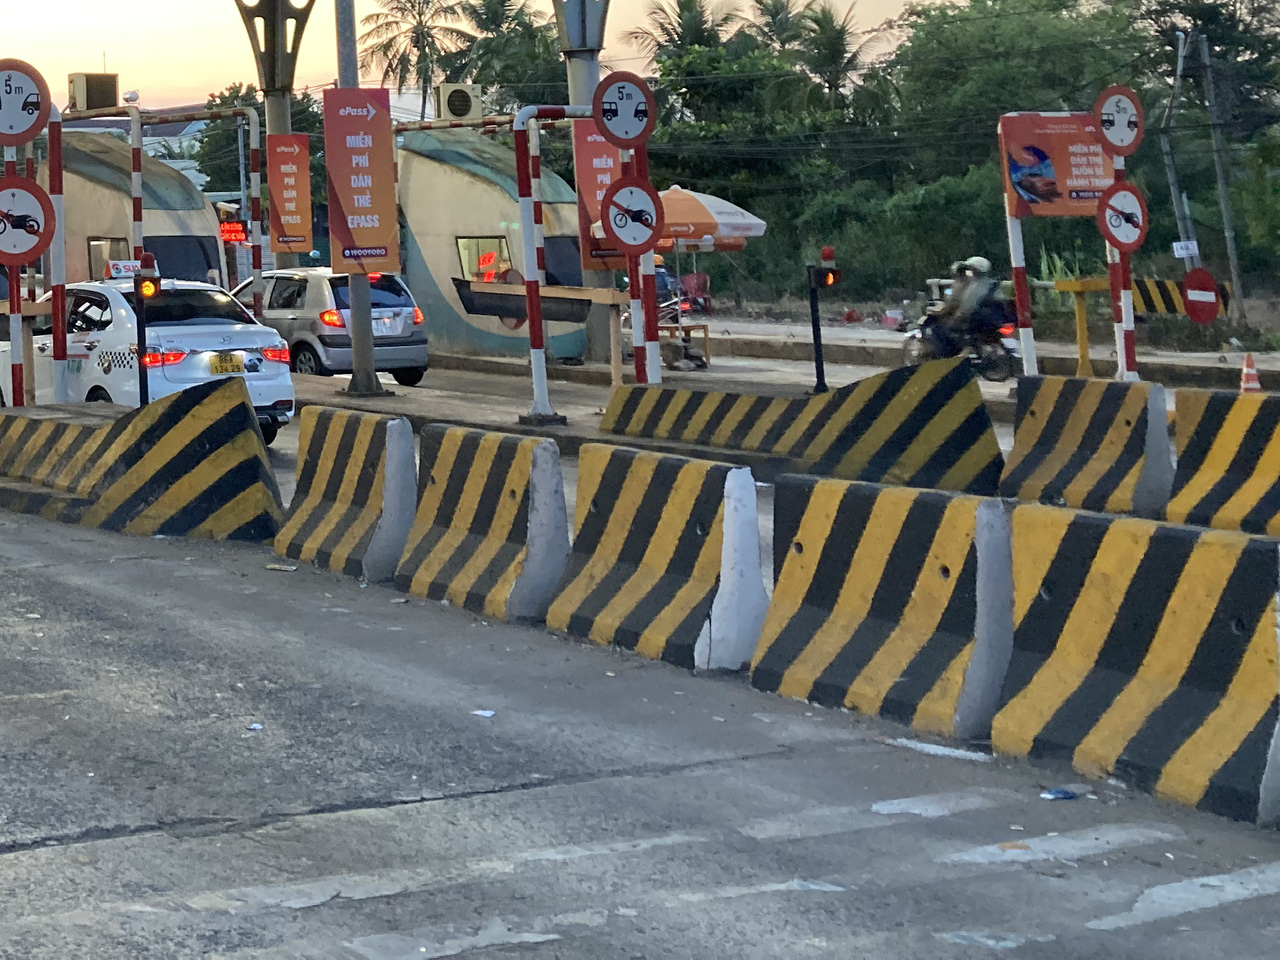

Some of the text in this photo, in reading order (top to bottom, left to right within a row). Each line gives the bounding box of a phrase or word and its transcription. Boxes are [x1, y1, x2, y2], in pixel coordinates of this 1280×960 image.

[339, 107, 368, 116] ePass
[346, 131, 373, 148] MIỄN
[352, 153, 369, 168] PHÍ
[351, 173, 372, 188] DÁN
[353, 191, 372, 208] THẺ
[348, 215, 379, 228] EPASS
